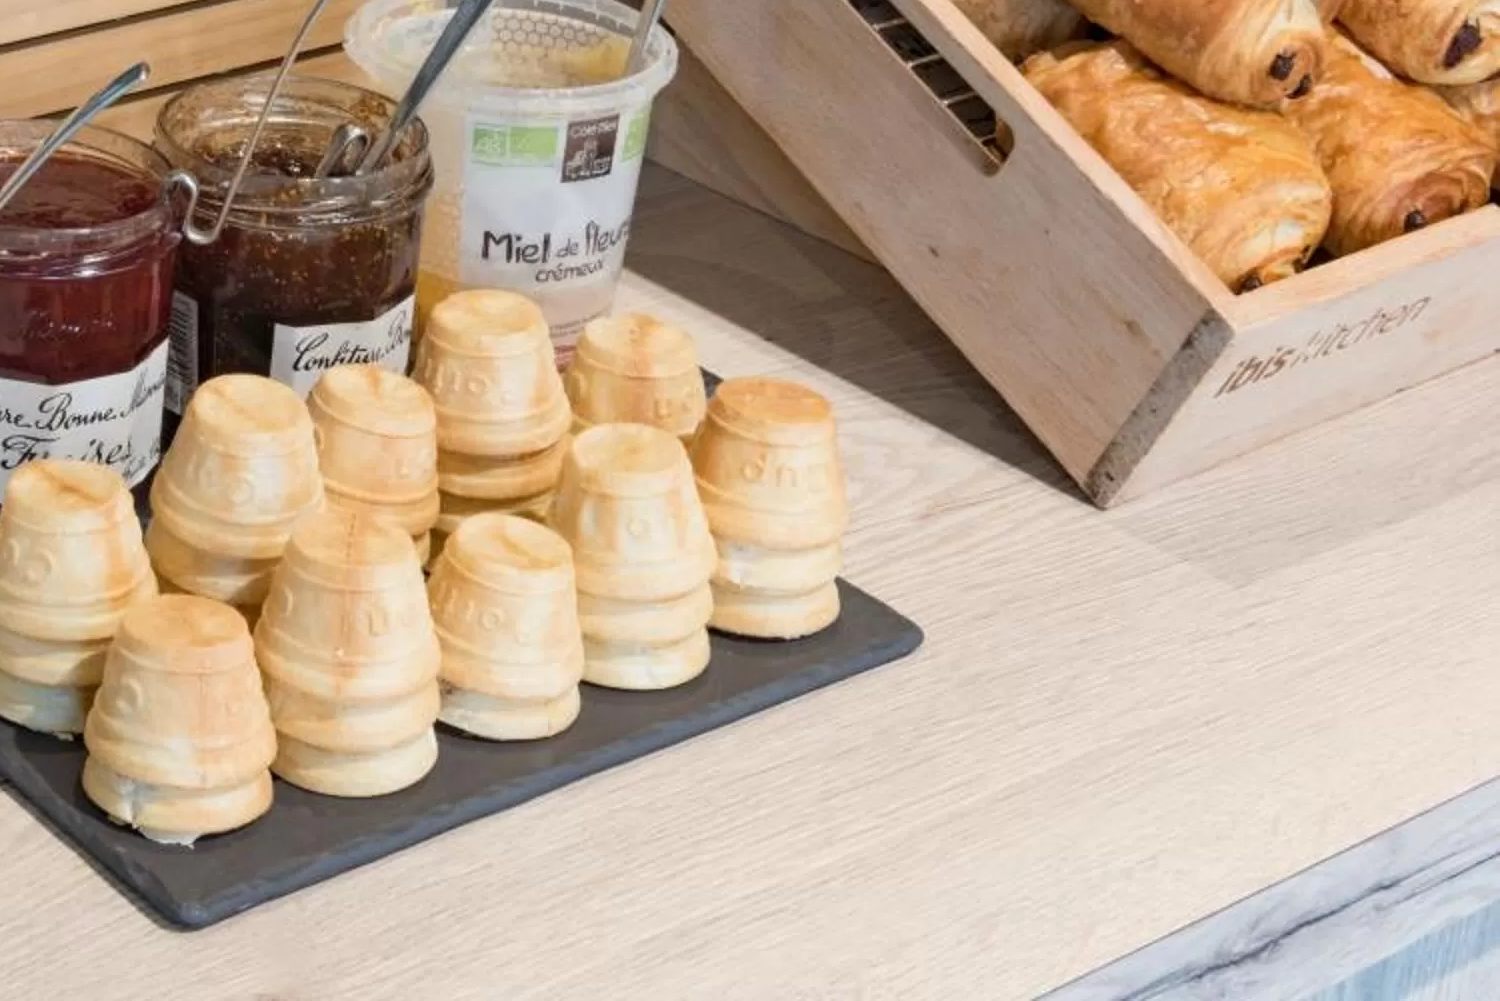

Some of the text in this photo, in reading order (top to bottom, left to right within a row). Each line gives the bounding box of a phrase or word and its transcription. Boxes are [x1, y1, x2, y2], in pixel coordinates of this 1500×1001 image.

[481, 219, 629, 264] Miel de fleur
[1214, 347, 1297, 399] ibis
[35, 392, 118, 431] Bonne
